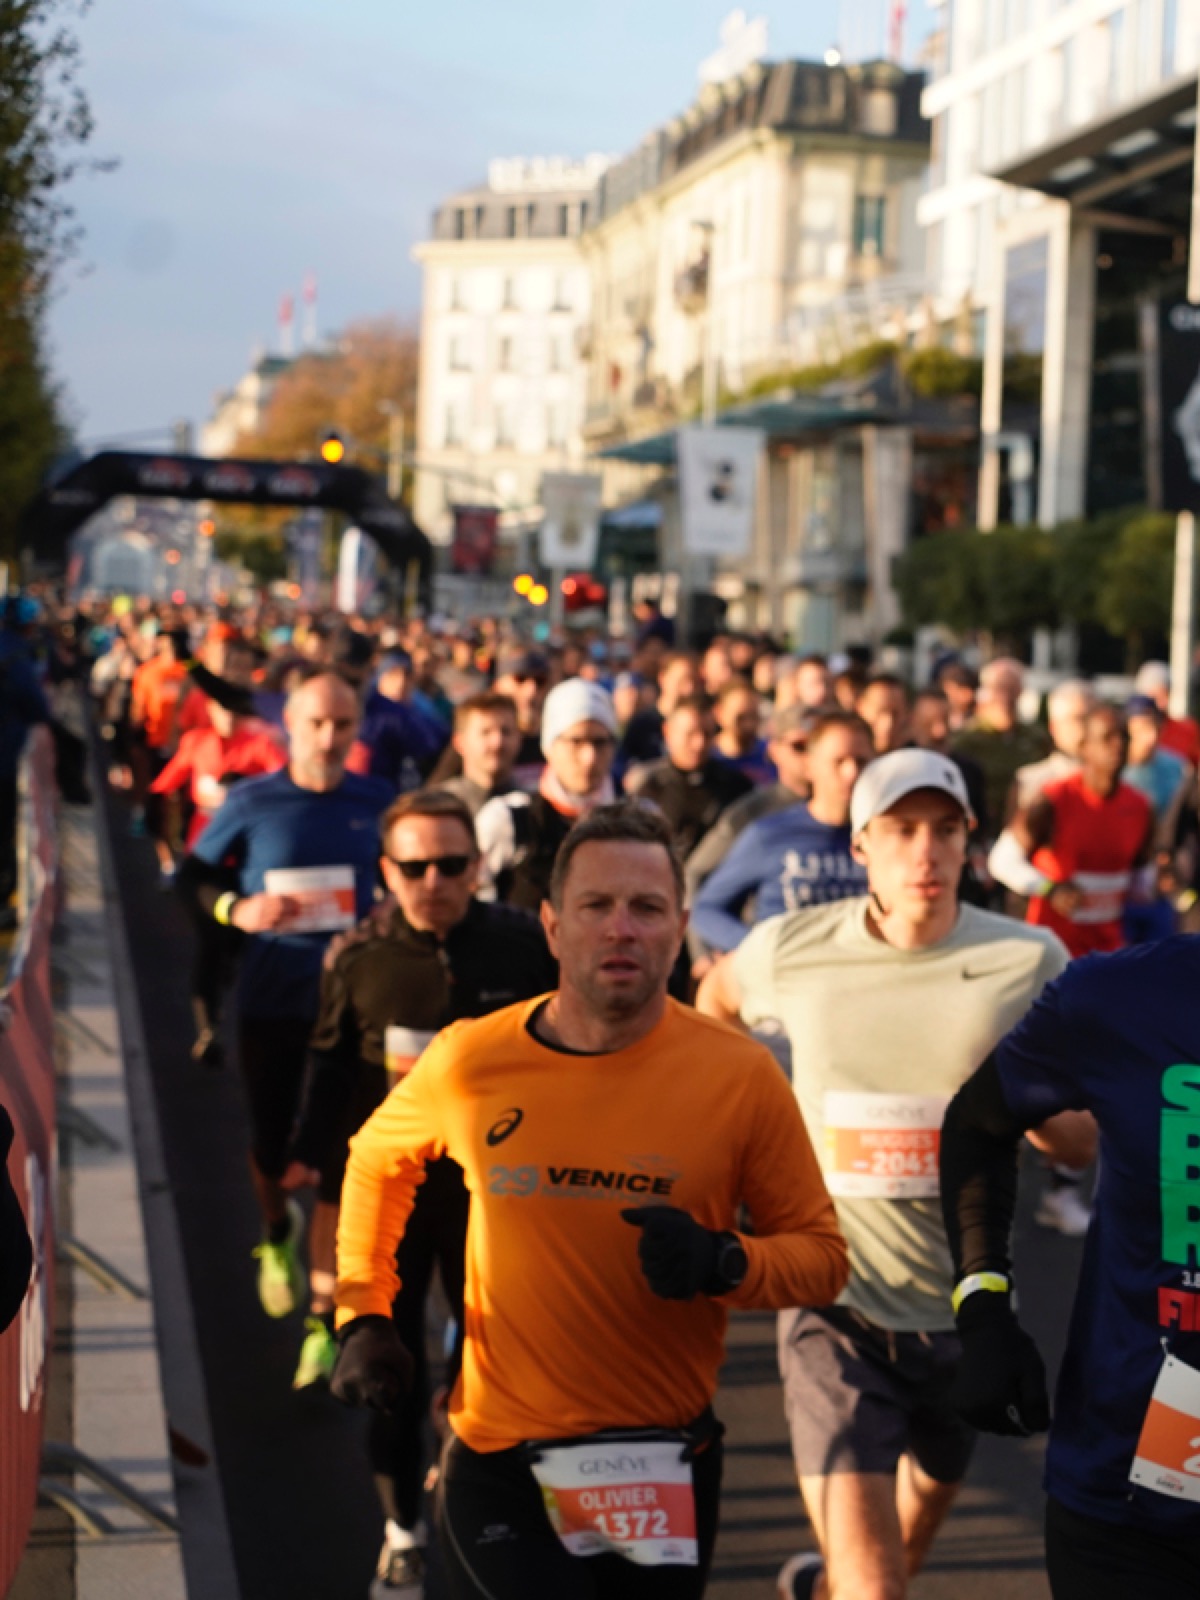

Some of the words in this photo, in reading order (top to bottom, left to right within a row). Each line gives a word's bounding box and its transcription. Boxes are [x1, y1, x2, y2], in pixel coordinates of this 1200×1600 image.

[488, 1165, 540, 1197] 29
[547, 1166, 675, 1195] VENICE
[578, 1486, 658, 1511] OLIVIER
[594, 1508, 669, 1540] 1372
